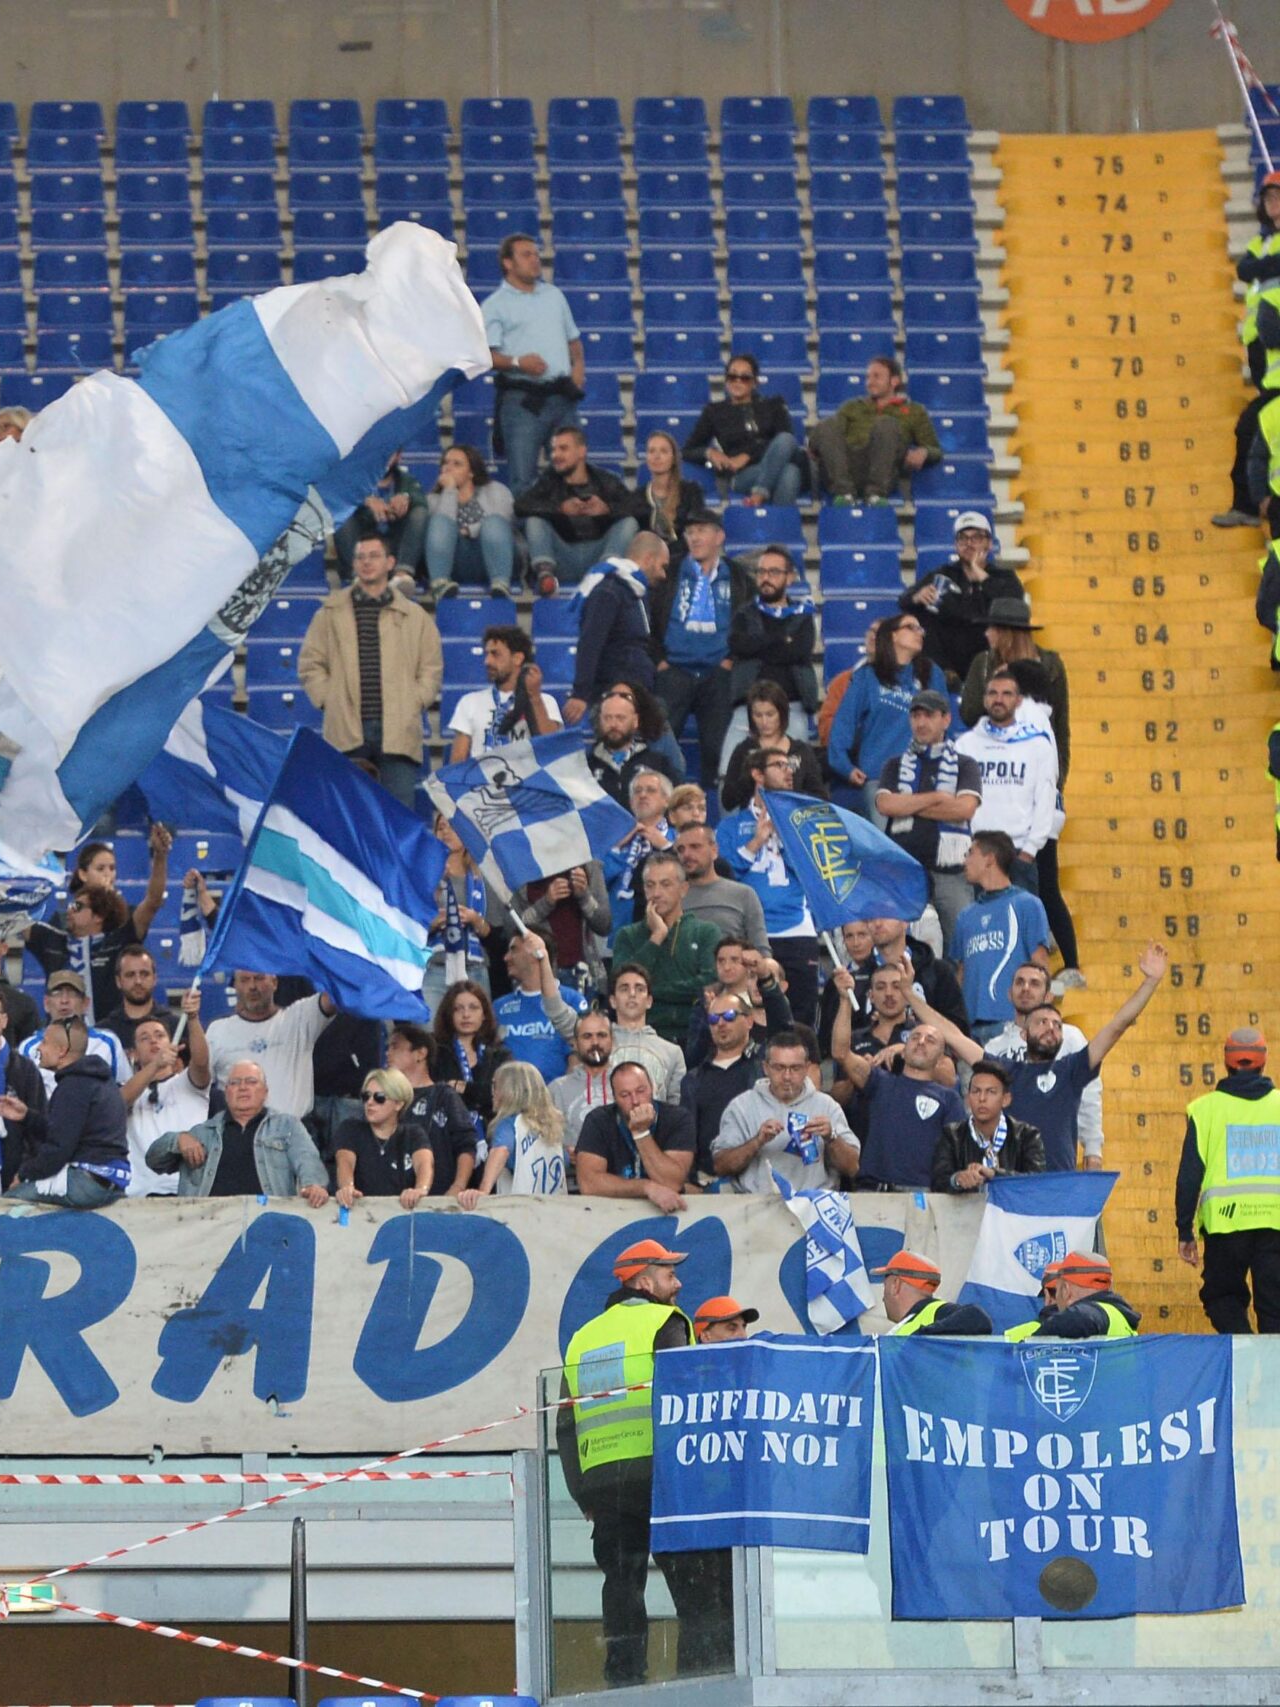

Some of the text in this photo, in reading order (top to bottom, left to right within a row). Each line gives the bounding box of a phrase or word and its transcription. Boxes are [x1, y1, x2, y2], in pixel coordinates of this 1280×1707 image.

[1093, 154, 1125, 177] 75
[1095, 193, 1129, 215] 74
[1101, 232, 1134, 254] 73
[1103, 272, 1135, 296] 72
[1106, 313, 1137, 336] 71
[1110, 355, 1144, 379] 70
[1114, 397, 1148, 420] 69
[1118, 440, 1152, 463] 68
[1124, 485, 1156, 510] 67
[1126, 530, 1161, 553] 66
[1131, 574, 1166, 598] 65
[1134, 623, 1170, 647] 64
[1140, 667, 1176, 693] 63
[1144, 719, 1179, 744] 62
[1149, 769, 1182, 794] 61
[1152, 816, 1188, 842] 60
[1158, 865, 1195, 890] 59
[1163, 913, 1201, 939] 58
[1169, 962, 1207, 989] 57
[507, 1021, 556, 1037] NGM
[1173, 1011, 1212, 1038] 56
[1178, 1061, 1216, 1087] 55
[659, 1389, 863, 1428] DIFFIDATI
[902, 1397, 1218, 1472] EMPOLESI
[675, 1430, 840, 1468] CON NOI
[1023, 1472, 1104, 1512] ON
[980, 1515, 1153, 1562] TOUR
